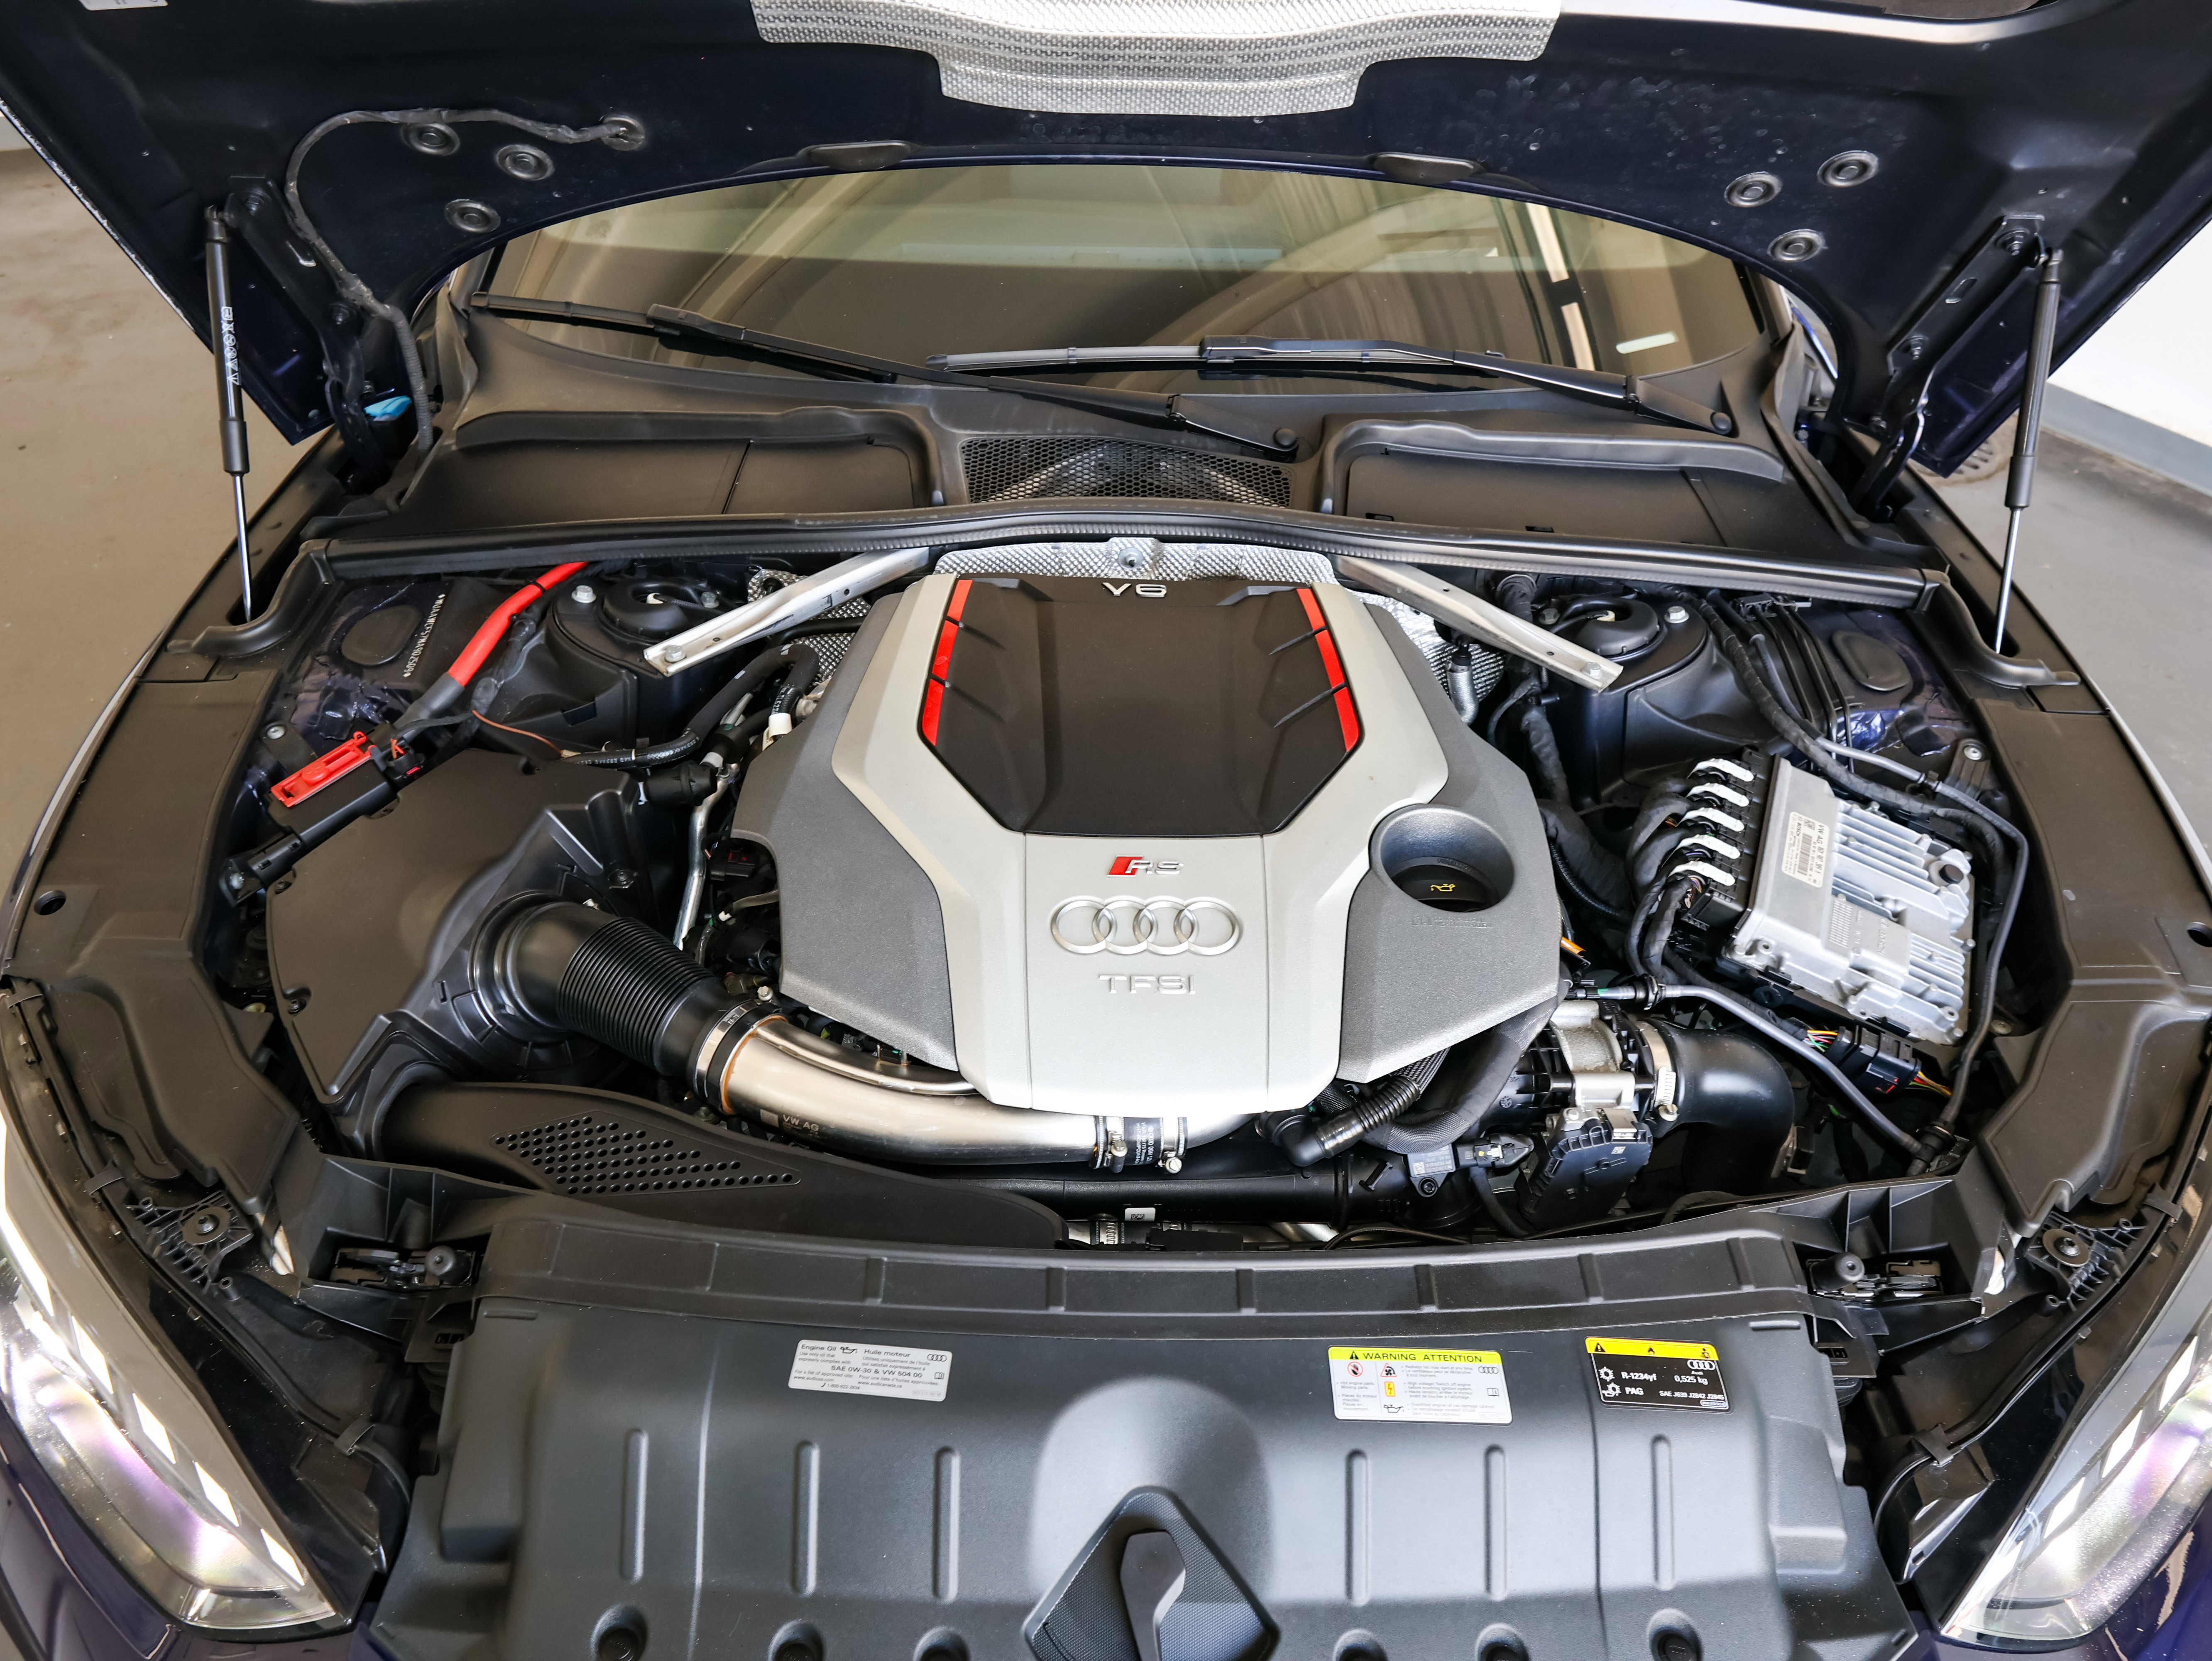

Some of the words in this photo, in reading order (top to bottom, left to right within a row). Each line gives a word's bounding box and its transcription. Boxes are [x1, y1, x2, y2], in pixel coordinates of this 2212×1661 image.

[1101, 582, 1167, 598] V6
[1816, 835, 1823, 844] AG
[1124, 859, 1184, 875] RS
[1098, 975, 1196, 995] TFSI
[783, 1114, 800, 1126] VW
[803, 1122, 819, 1132] AG
[800, 1343, 825, 1352] Engine
[1423, 1354, 1482, 1362] ATTENTION
[1621, 1372, 1657, 1382] R-1234yf
[1674, 1375, 1697, 1383] 0,525
[1697, 1376, 1709, 1385] kg
[1625, 1387, 1644, 1395] PAG
